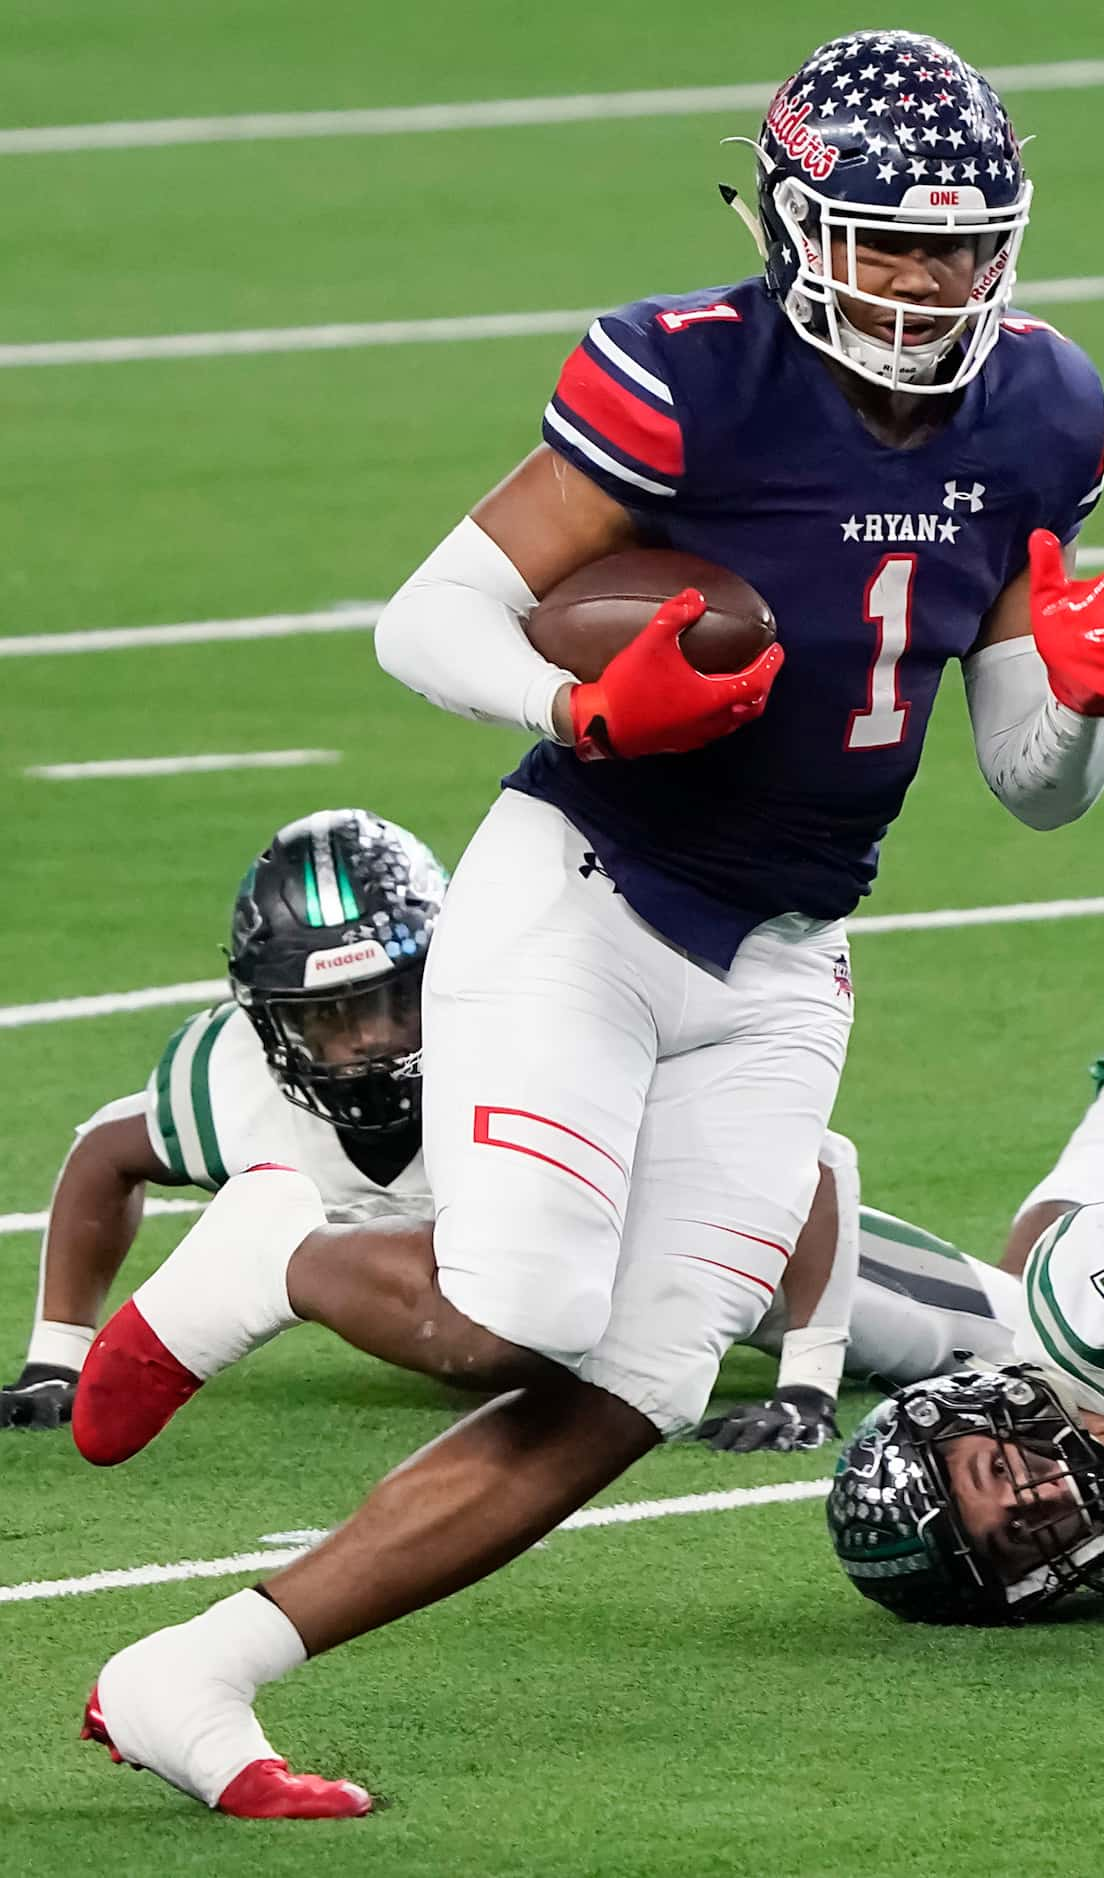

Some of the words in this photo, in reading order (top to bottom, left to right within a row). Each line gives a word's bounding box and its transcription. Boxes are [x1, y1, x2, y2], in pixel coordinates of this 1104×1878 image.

[930, 190, 960, 206] ONE
[971, 249, 1009, 301] Riddell
[656, 302, 743, 334] 1
[863, 513, 938, 542] RYAN
[843, 552, 918, 752] 1
[315, 948, 376, 971] Riddell
